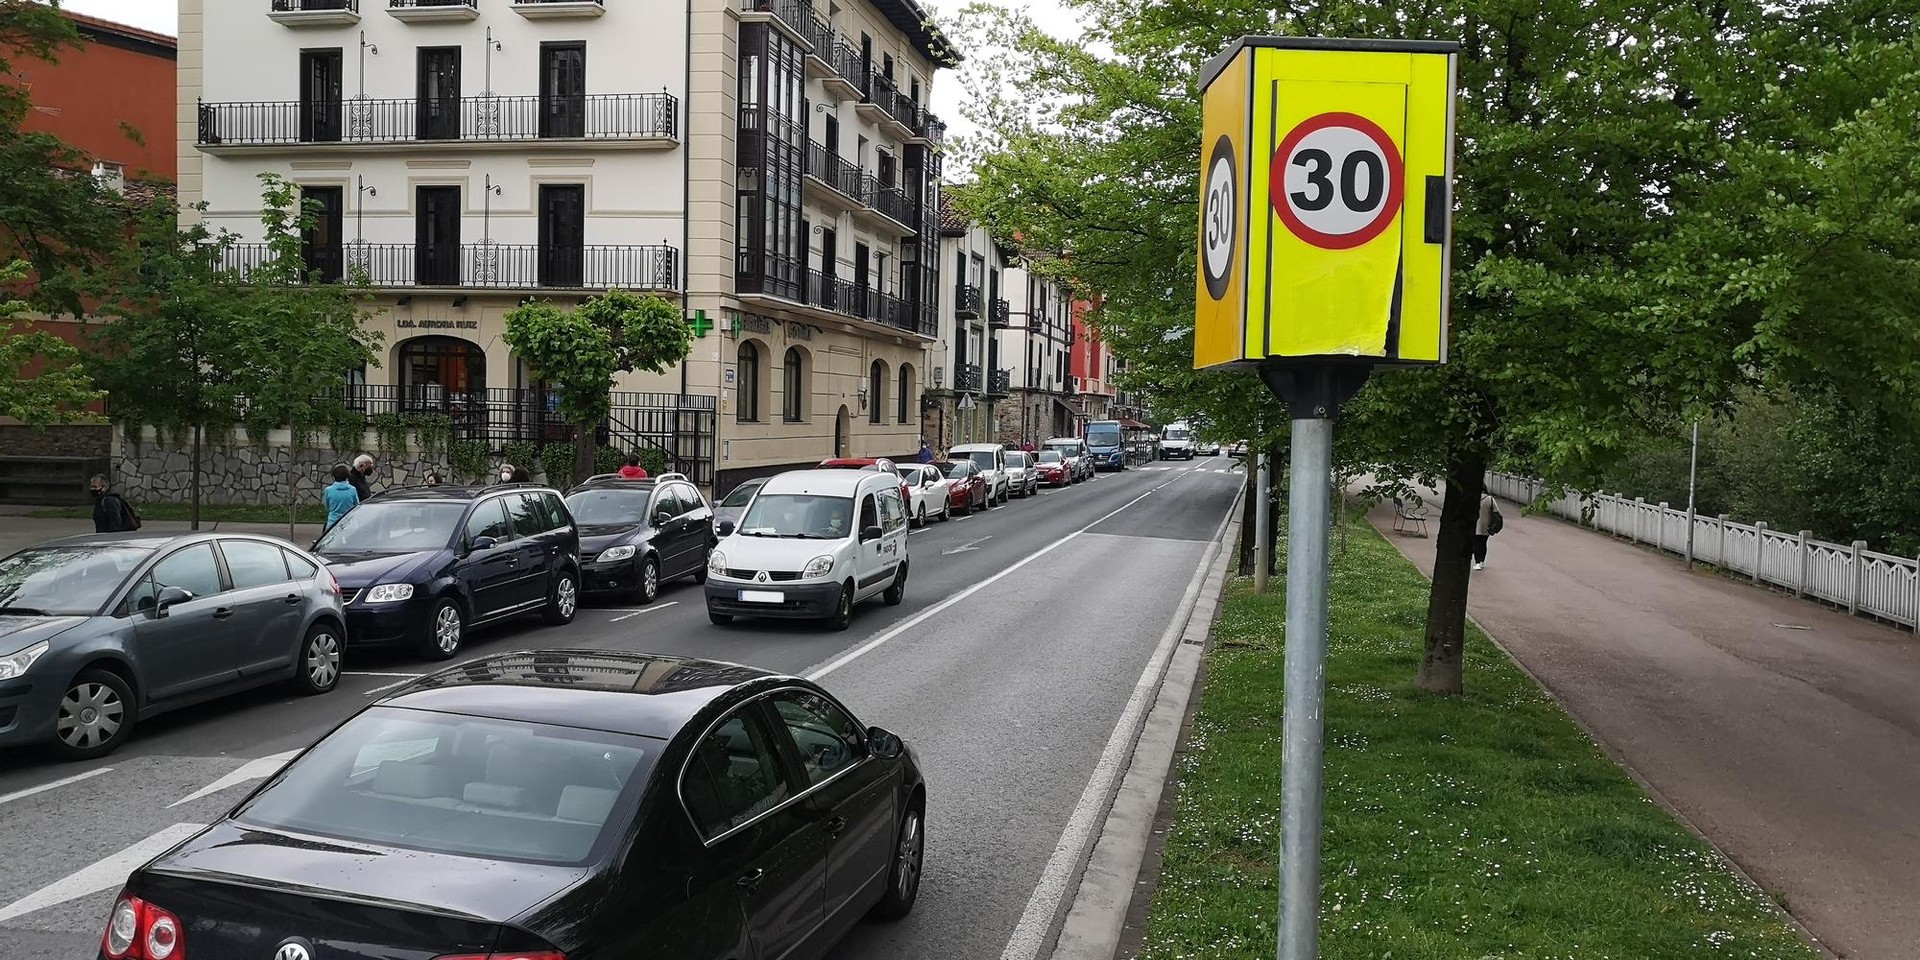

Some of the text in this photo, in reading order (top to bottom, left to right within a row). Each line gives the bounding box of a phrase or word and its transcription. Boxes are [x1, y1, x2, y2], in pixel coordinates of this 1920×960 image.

[1290, 148, 1384, 213] 30
[1209, 180, 1230, 251] 30
[418, 320, 455, 329] AURORA
[456, 320, 478, 330] RUIZ
